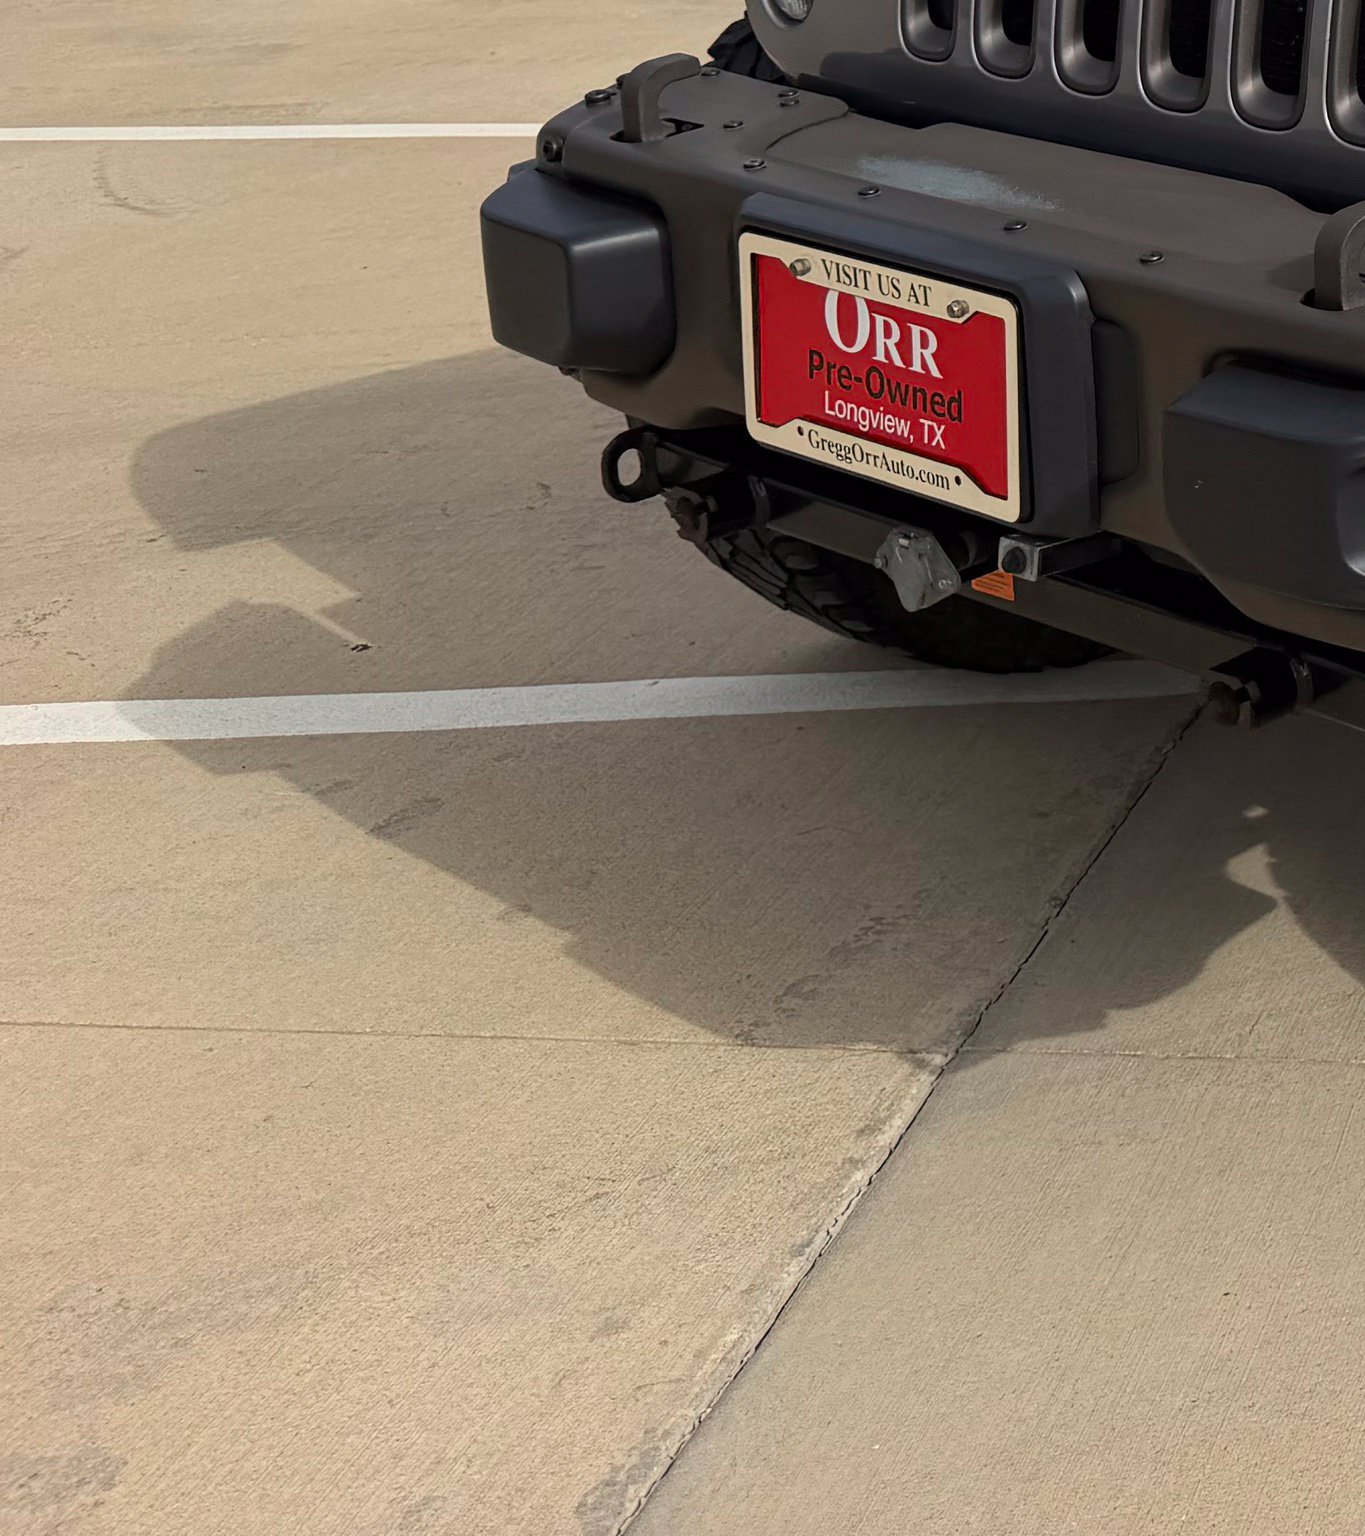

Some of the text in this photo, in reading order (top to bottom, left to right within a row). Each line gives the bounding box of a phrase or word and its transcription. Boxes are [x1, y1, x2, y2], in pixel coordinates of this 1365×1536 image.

[820, 259, 932, 307] VISIT US AT
[808, 349, 963, 424] Pre-Owned
[824, 390, 947, 450] Longview, TX
[808, 429, 951, 491] GreggOrrAuto.com
